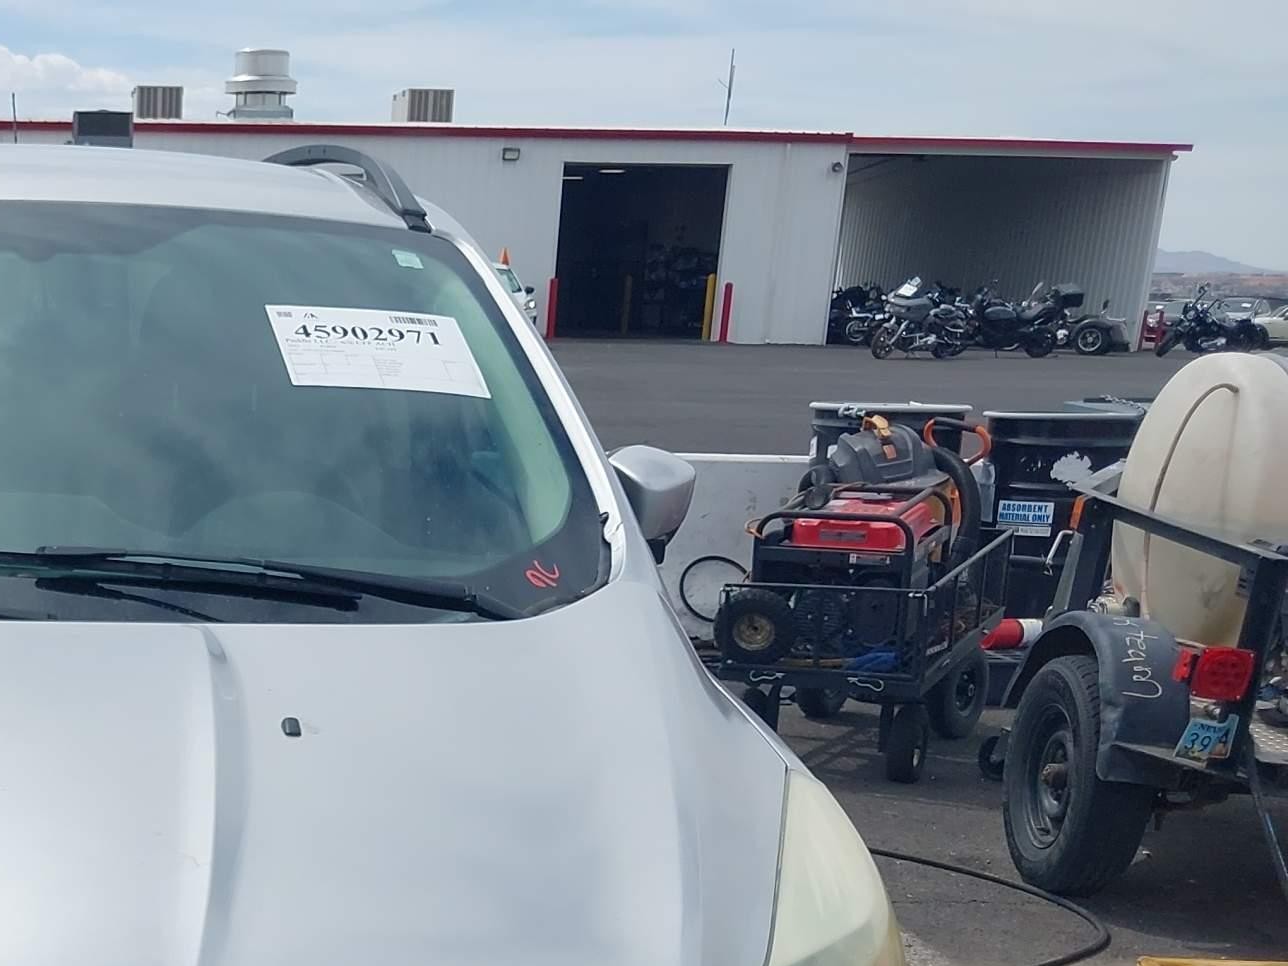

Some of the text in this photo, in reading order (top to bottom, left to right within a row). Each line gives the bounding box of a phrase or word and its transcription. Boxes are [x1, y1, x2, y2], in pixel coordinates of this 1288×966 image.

[294, 323, 442, 346] 45902971
[1001, 502, 1049, 513] ABSORBENT
[999, 511, 1051, 523] MATERIAL ONLY
